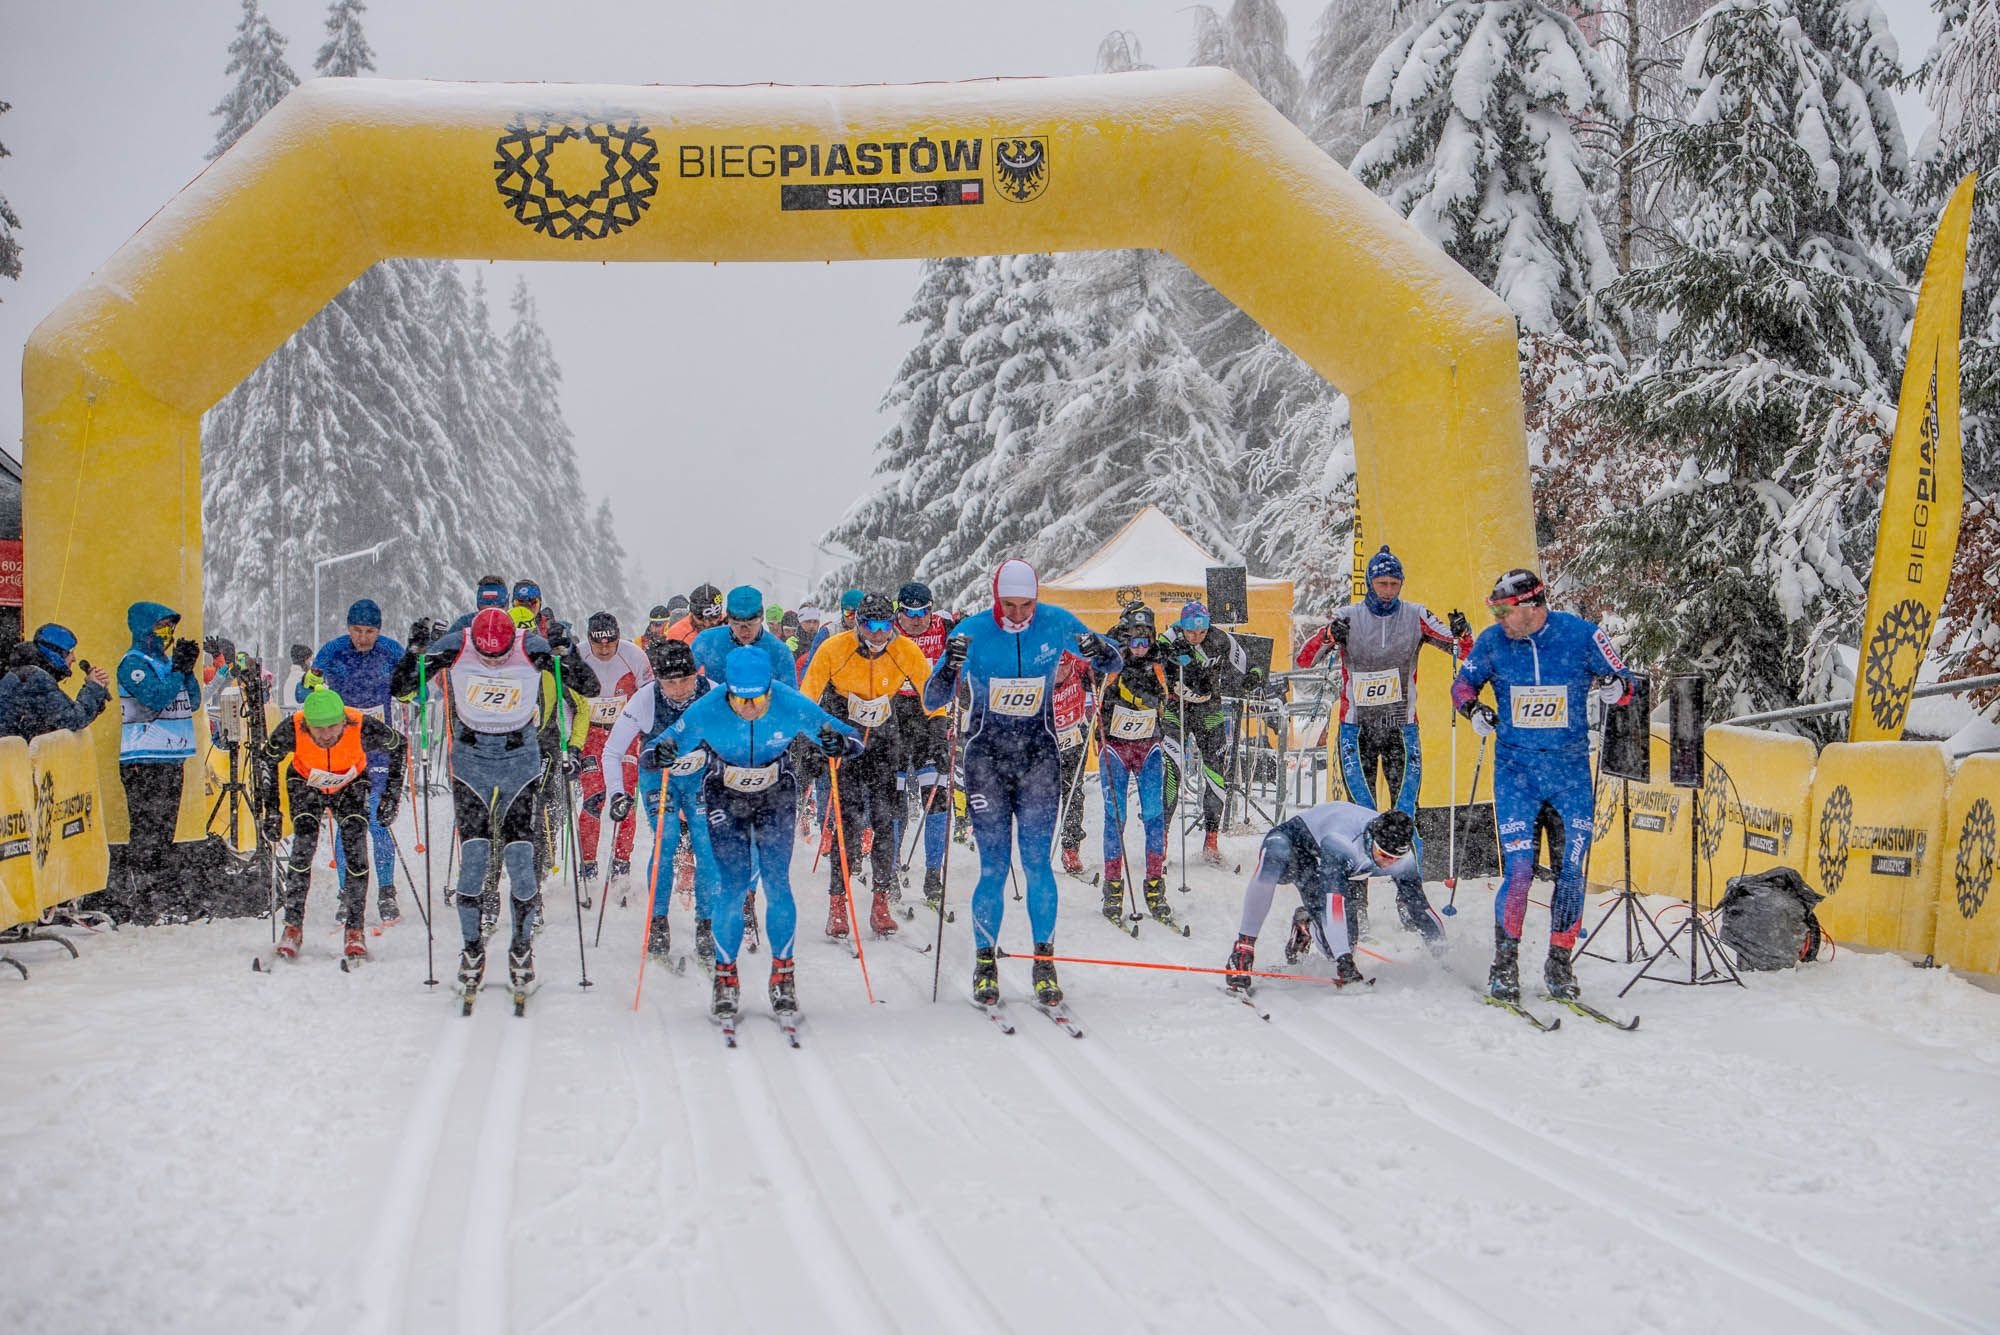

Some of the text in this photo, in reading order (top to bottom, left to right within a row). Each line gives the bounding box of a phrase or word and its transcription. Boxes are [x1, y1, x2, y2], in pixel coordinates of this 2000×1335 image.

[827, 185, 937, 206] SKIRACES
[1, 560, 23, 572] 602
[1602, 642, 1623, 670] LOTOS
[1367, 684, 1387, 697] 60
[482, 691, 505, 705] 72
[1002, 693, 1036, 707] 109
[600, 706, 617, 717] 19
[859, 710, 878, 721] 71
[1521, 703, 1557, 717] 120
[1055, 711, 1075, 727] 31
[1123, 721, 1144, 732] 87
[740, 777, 765, 786] 83
